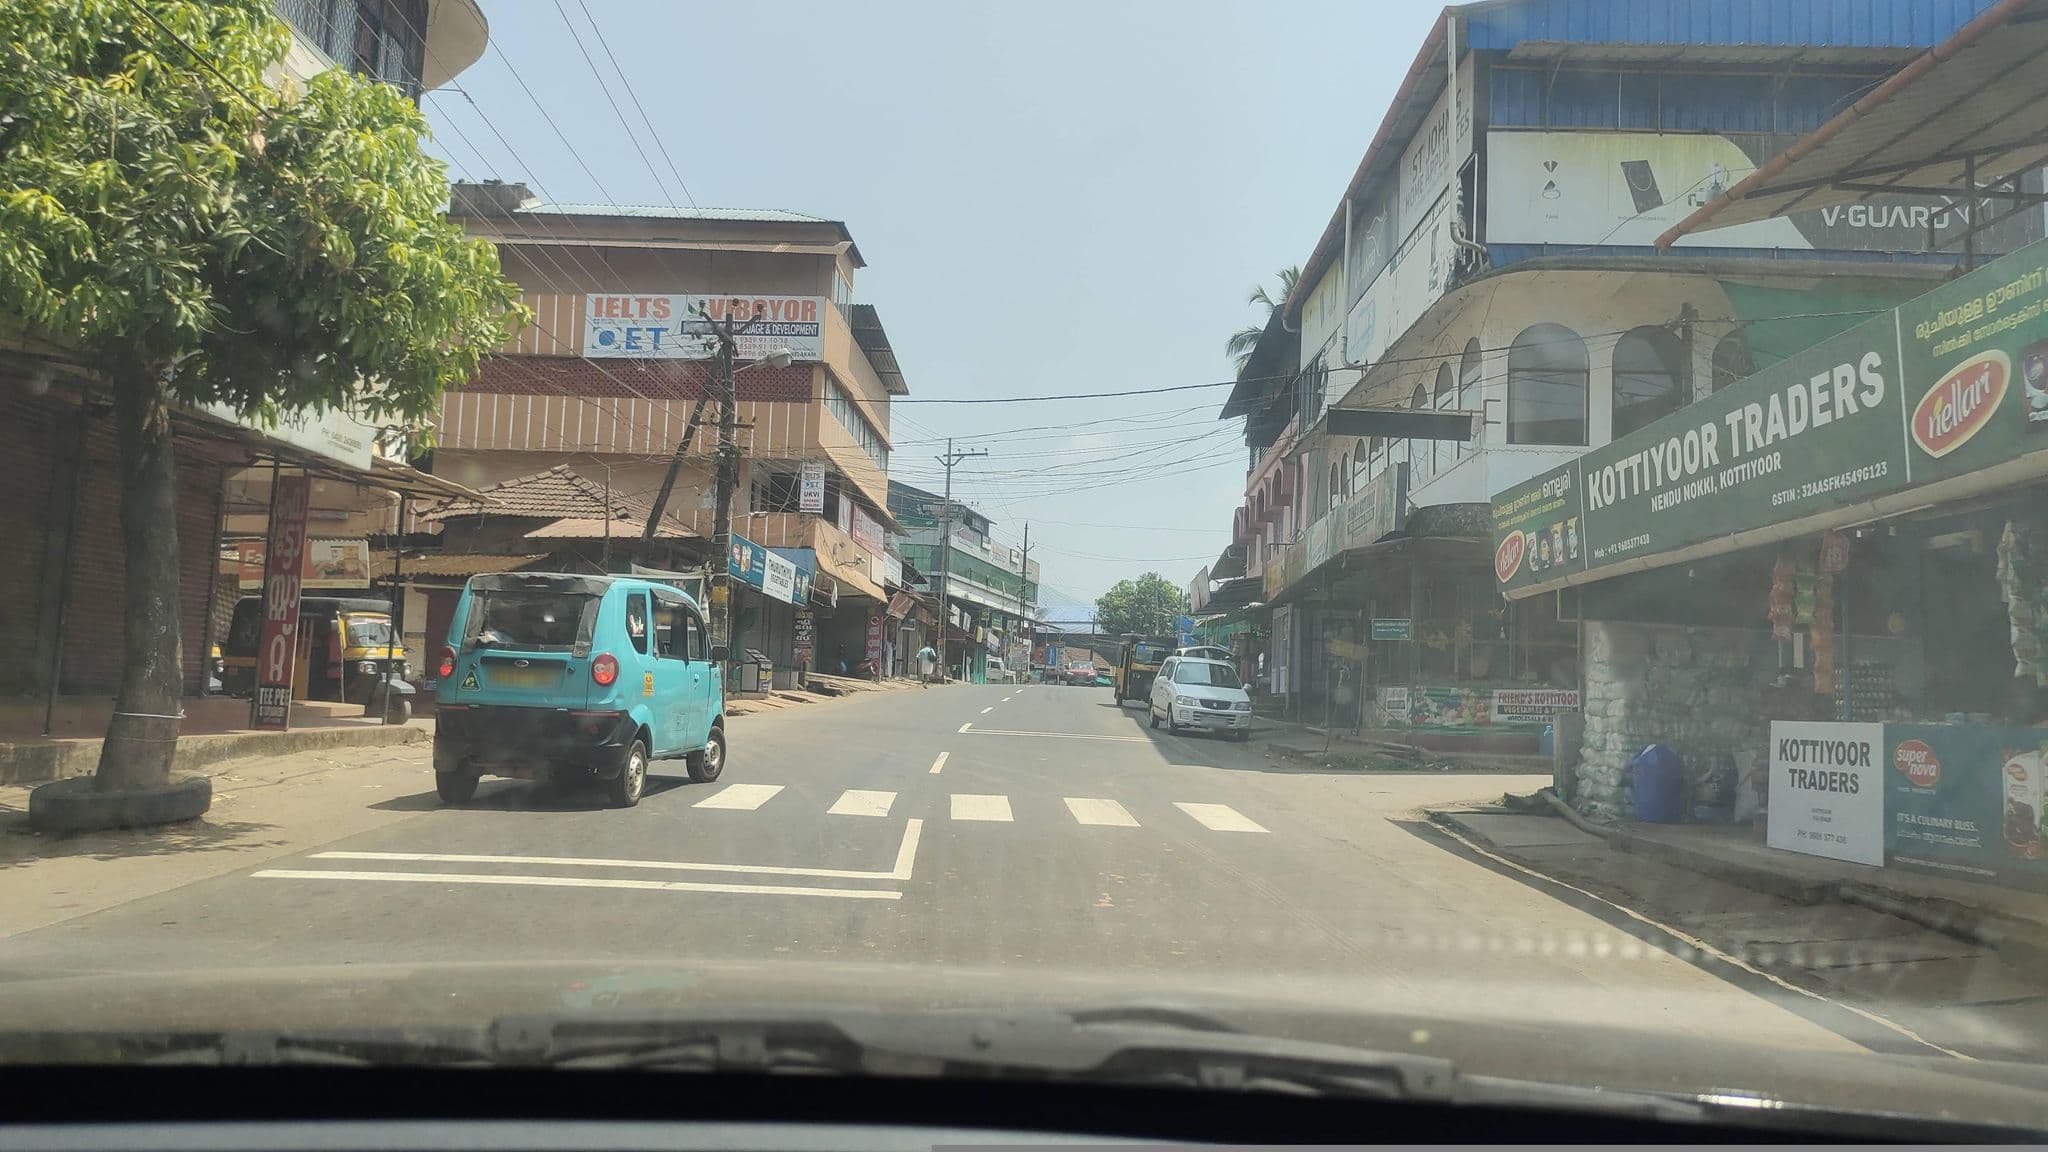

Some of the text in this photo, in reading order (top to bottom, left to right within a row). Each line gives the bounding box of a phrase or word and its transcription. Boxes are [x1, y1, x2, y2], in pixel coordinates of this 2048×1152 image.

[1821, 204, 1950, 229] V-GUARD
[594, 296, 817, 322] IELTS VIBGYOR
[772, 323, 818, 336] DEVELOPMENT
[1928, 362, 1991, 439] nellari
[1588, 352, 1885, 511] KOTTIYOOR TRADERS
[1650, 452, 1782, 513] NENDU NOKKI, KOTTIYOOR
[1771, 487, 1796, 507] GSTIN
[1498, 691, 1533, 705] FRIEND'S
[1779, 738, 1871, 767] KOTTIYOOR
[1896, 749, 1929, 767] super
[1788, 768, 1859, 795] TRADERS
[1909, 763, 1937, 777] nova
